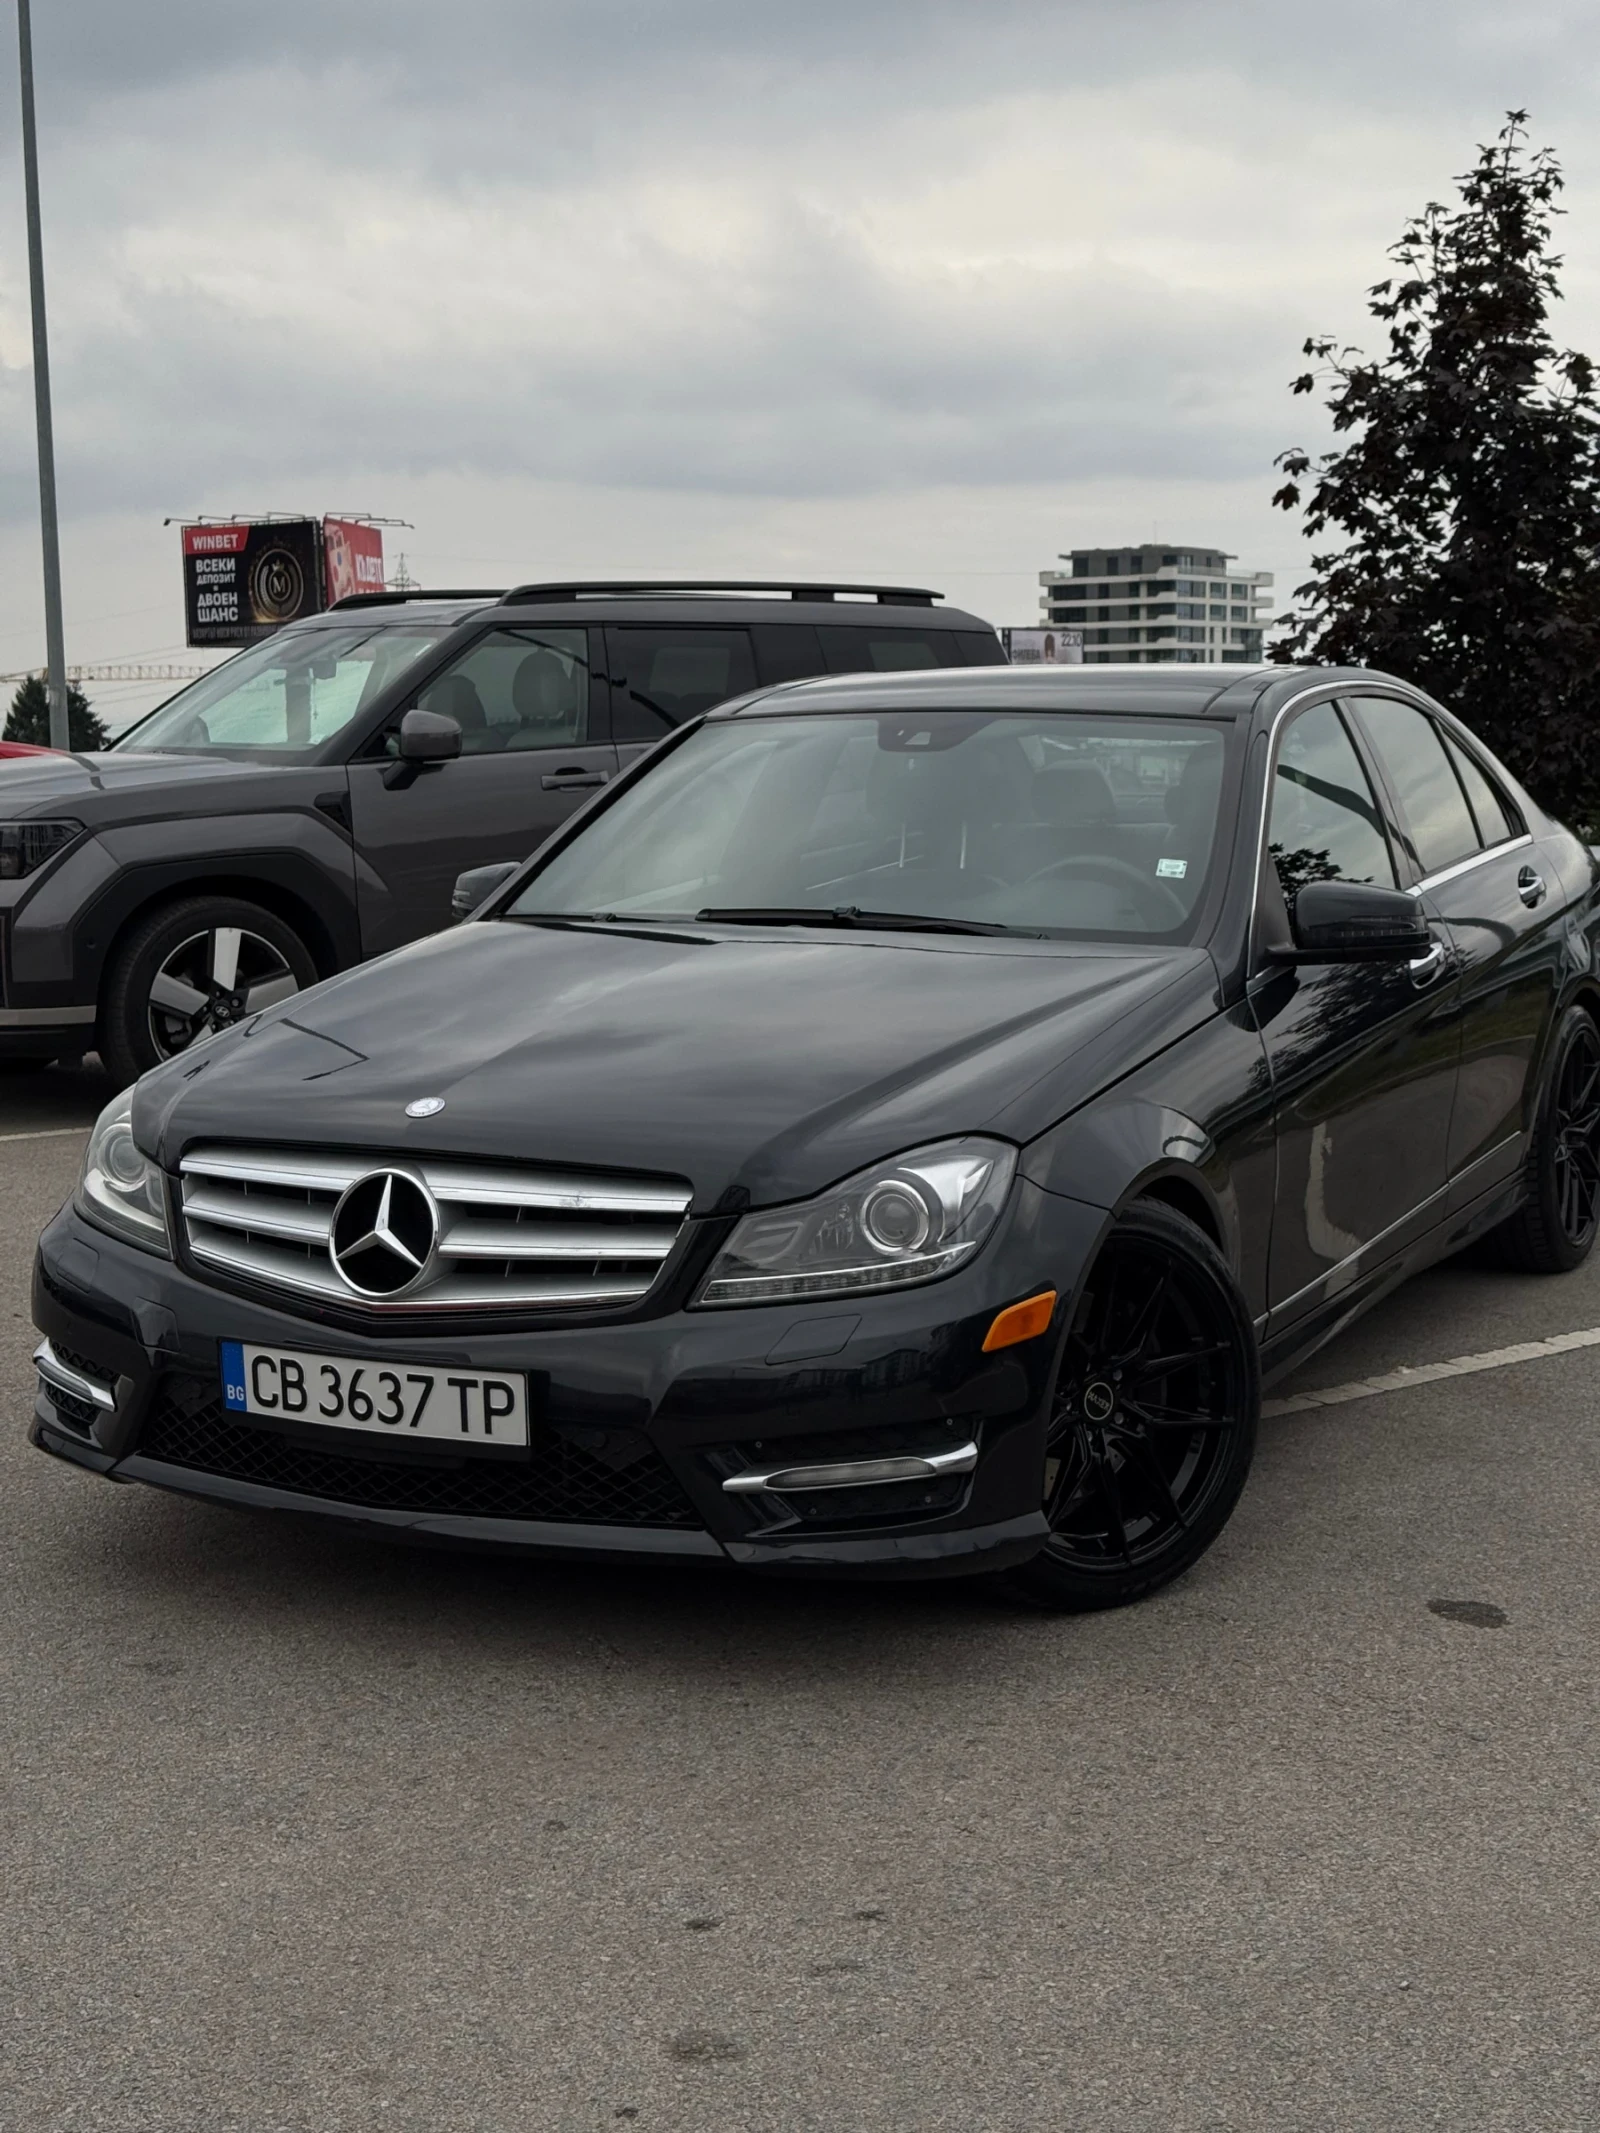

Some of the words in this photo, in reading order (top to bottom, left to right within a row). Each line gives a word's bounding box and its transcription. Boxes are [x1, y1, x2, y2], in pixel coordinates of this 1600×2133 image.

[192, 534, 239, 551] WINBET
[195, 558, 236, 573] ВСЕКИ
[196, 573, 236, 586] ДЕПОЗИТ
[272, 576, 286, 594] M
[197, 592, 238, 608] ДВОЕН
[197, 606, 239, 623] ШАНС
[226, 1384, 245, 1402] BG
[251, 1354, 308, 1412] CB
[319, 1364, 435, 1428] 3637
[447, 1377, 515, 1435] TP
